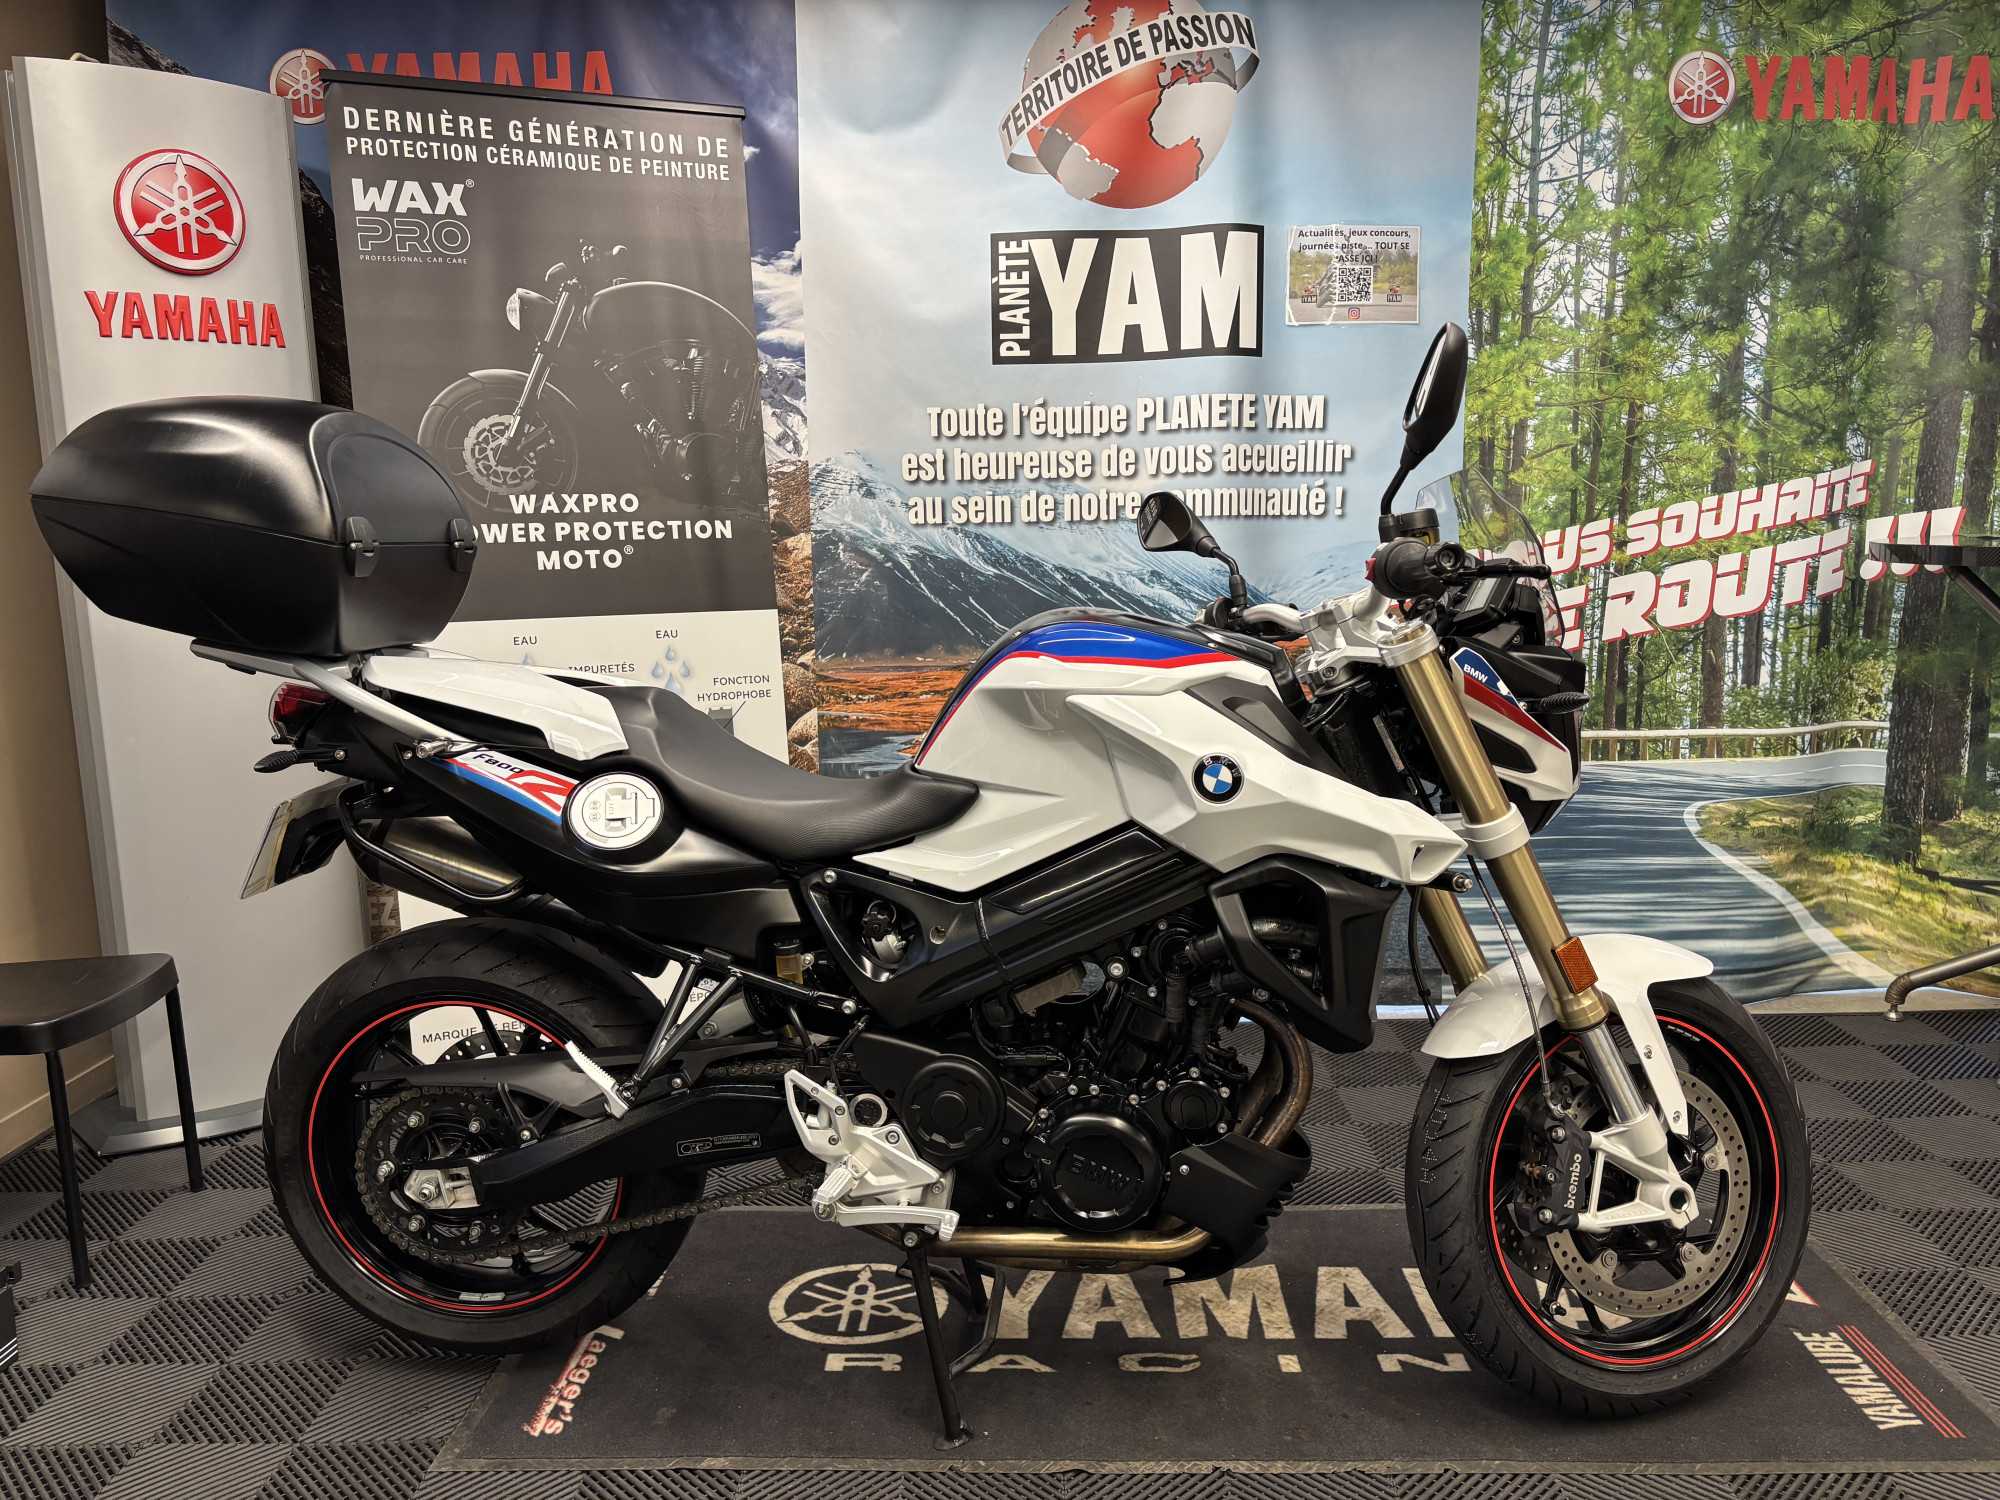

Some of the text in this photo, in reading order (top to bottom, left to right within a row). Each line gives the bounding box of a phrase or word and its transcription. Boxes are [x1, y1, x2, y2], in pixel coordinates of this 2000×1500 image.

[1000, 14, 1257, 148] TERRITOIRE DE PASSION
[1744, 55, 1994, 124] YAMAHA
[343, 106, 729, 159] DERNIÈRE GÉNÉRATION DE
[346, 136, 730, 181] PROTECTION CÉRAMIQUE DE PEINTURE
[356, 216, 471, 255] PRO
[1348, 228, 1368, 239] jeux
[1370, 229, 1411, 239] concours,
[1375, 241, 1399, 250] TOUT
[1401, 242, 1410, 250] SE
[359, 254, 424, 263] PROFESSIONAL
[446, 257, 468, 265] CARE
[1336, 254, 1360, 263] ASSE
[991, 230, 1259, 358] PLANÈTE YAM
[84, 290, 287, 349] YAMAHA
[927, 403, 1004, 437] Toute
[1136, 393, 1256, 432] PLANETE
[1264, 395, 1325, 429] YAM
[901, 439, 1352, 482] est heureuse de vous accueillir
[509, 493, 639, 514] WAXPRO
[908, 494, 943, 525] au
[951, 490, 1012, 524] sein
[1021, 489, 1056, 522] de
[1064, 489, 1141, 522] notre
[1335, 486, 1344, 515] !
[555, 520, 733, 541] PROTECTION
[1602, 526, 1851, 643] ROUTE
[513, 635, 538, 646] EAU
[655, 629, 679, 640] EAU
[713, 675, 770, 687] FONCTION
[1463, 663, 1489, 683] BMW
[697, 689, 772, 702] HYDROPHOBE
[422, 1026, 477, 1044] MARQUE
[1068, 1153, 1131, 1193] BMW
[1563, 1153, 1582, 1210] brembo
